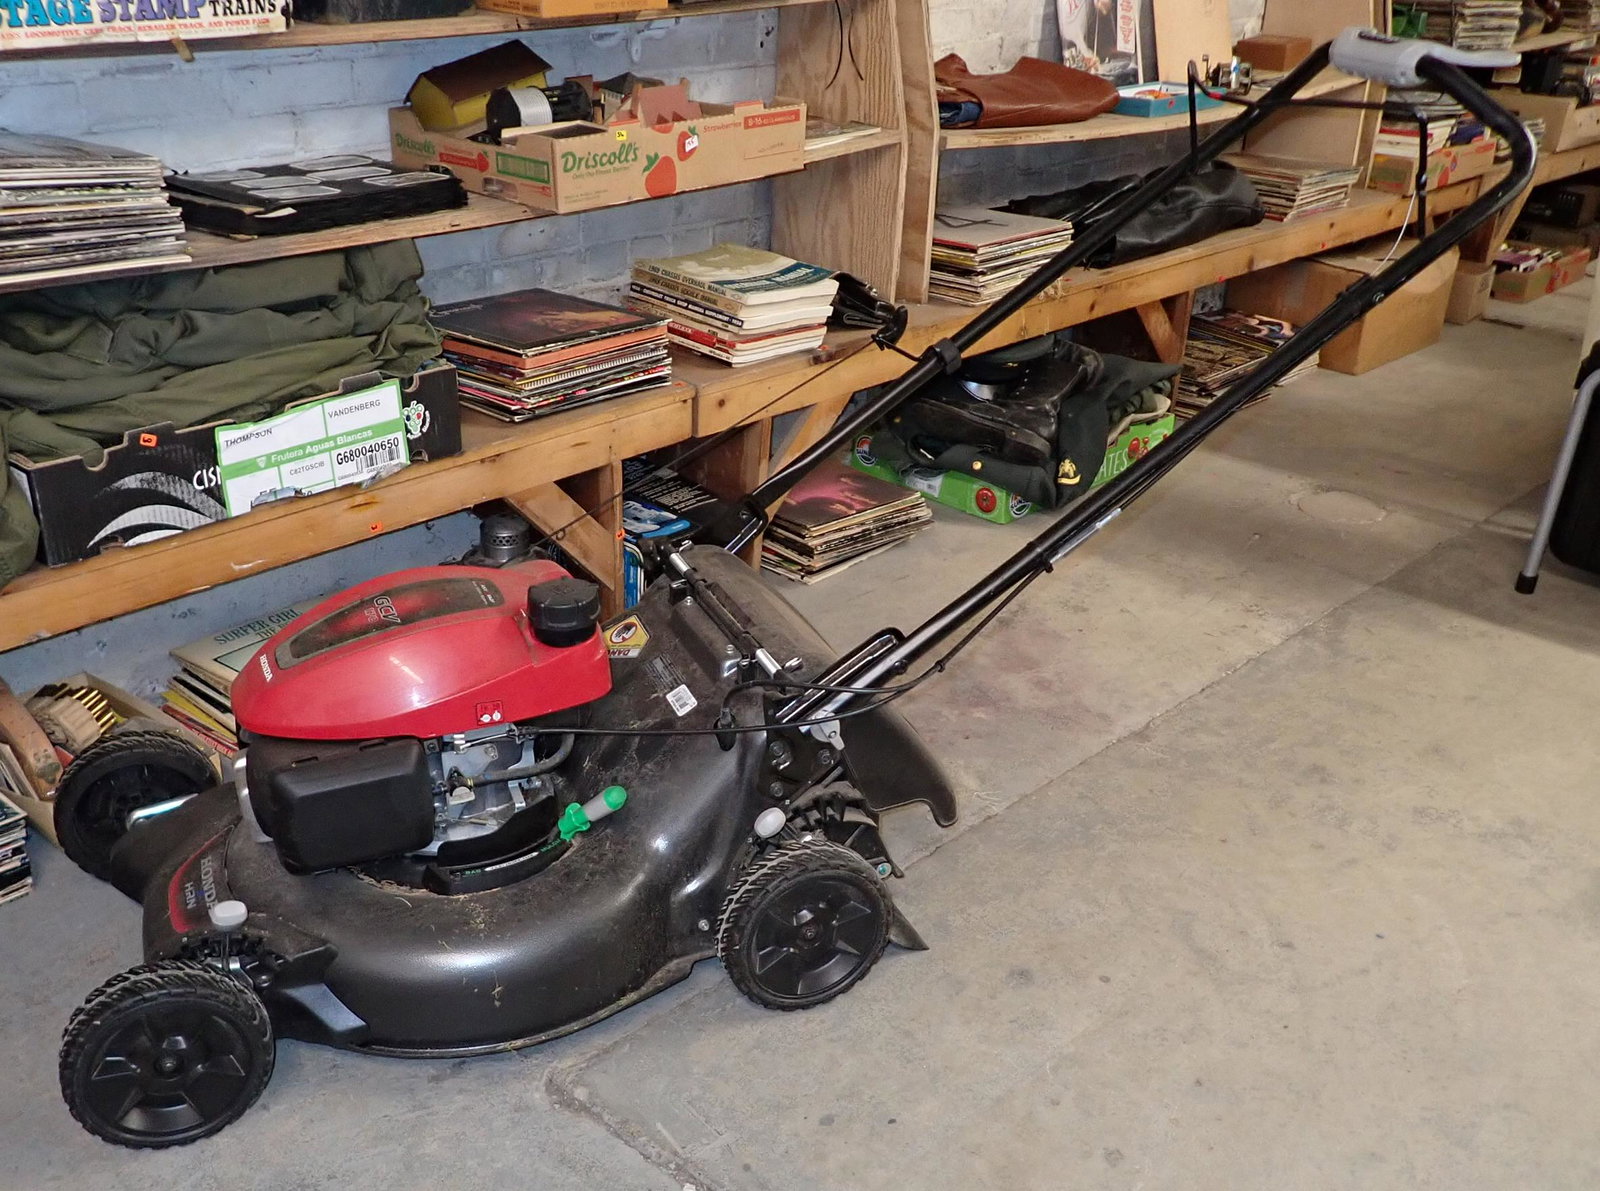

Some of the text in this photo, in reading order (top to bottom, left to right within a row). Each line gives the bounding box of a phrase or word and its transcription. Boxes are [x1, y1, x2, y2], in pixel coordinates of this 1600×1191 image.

[0, 0, 277, 28] TAGE STAMP TRAINS
[561, 142, 640, 173] Driscoll's
[707, 282, 728, 296] MANUAL
[327, 399, 381, 419] VANDENBERG
[224, 427, 273, 448] THOMPSON
[271, 429, 374, 464] Frutera Aguas Blancas
[336, 436, 400, 466] G680040650
[373, 594, 401, 624] GCV
[214, 608, 303, 645] SURFER GIRL
[259, 653, 273, 683] HONDA
[185, 881, 196, 909] HRN
